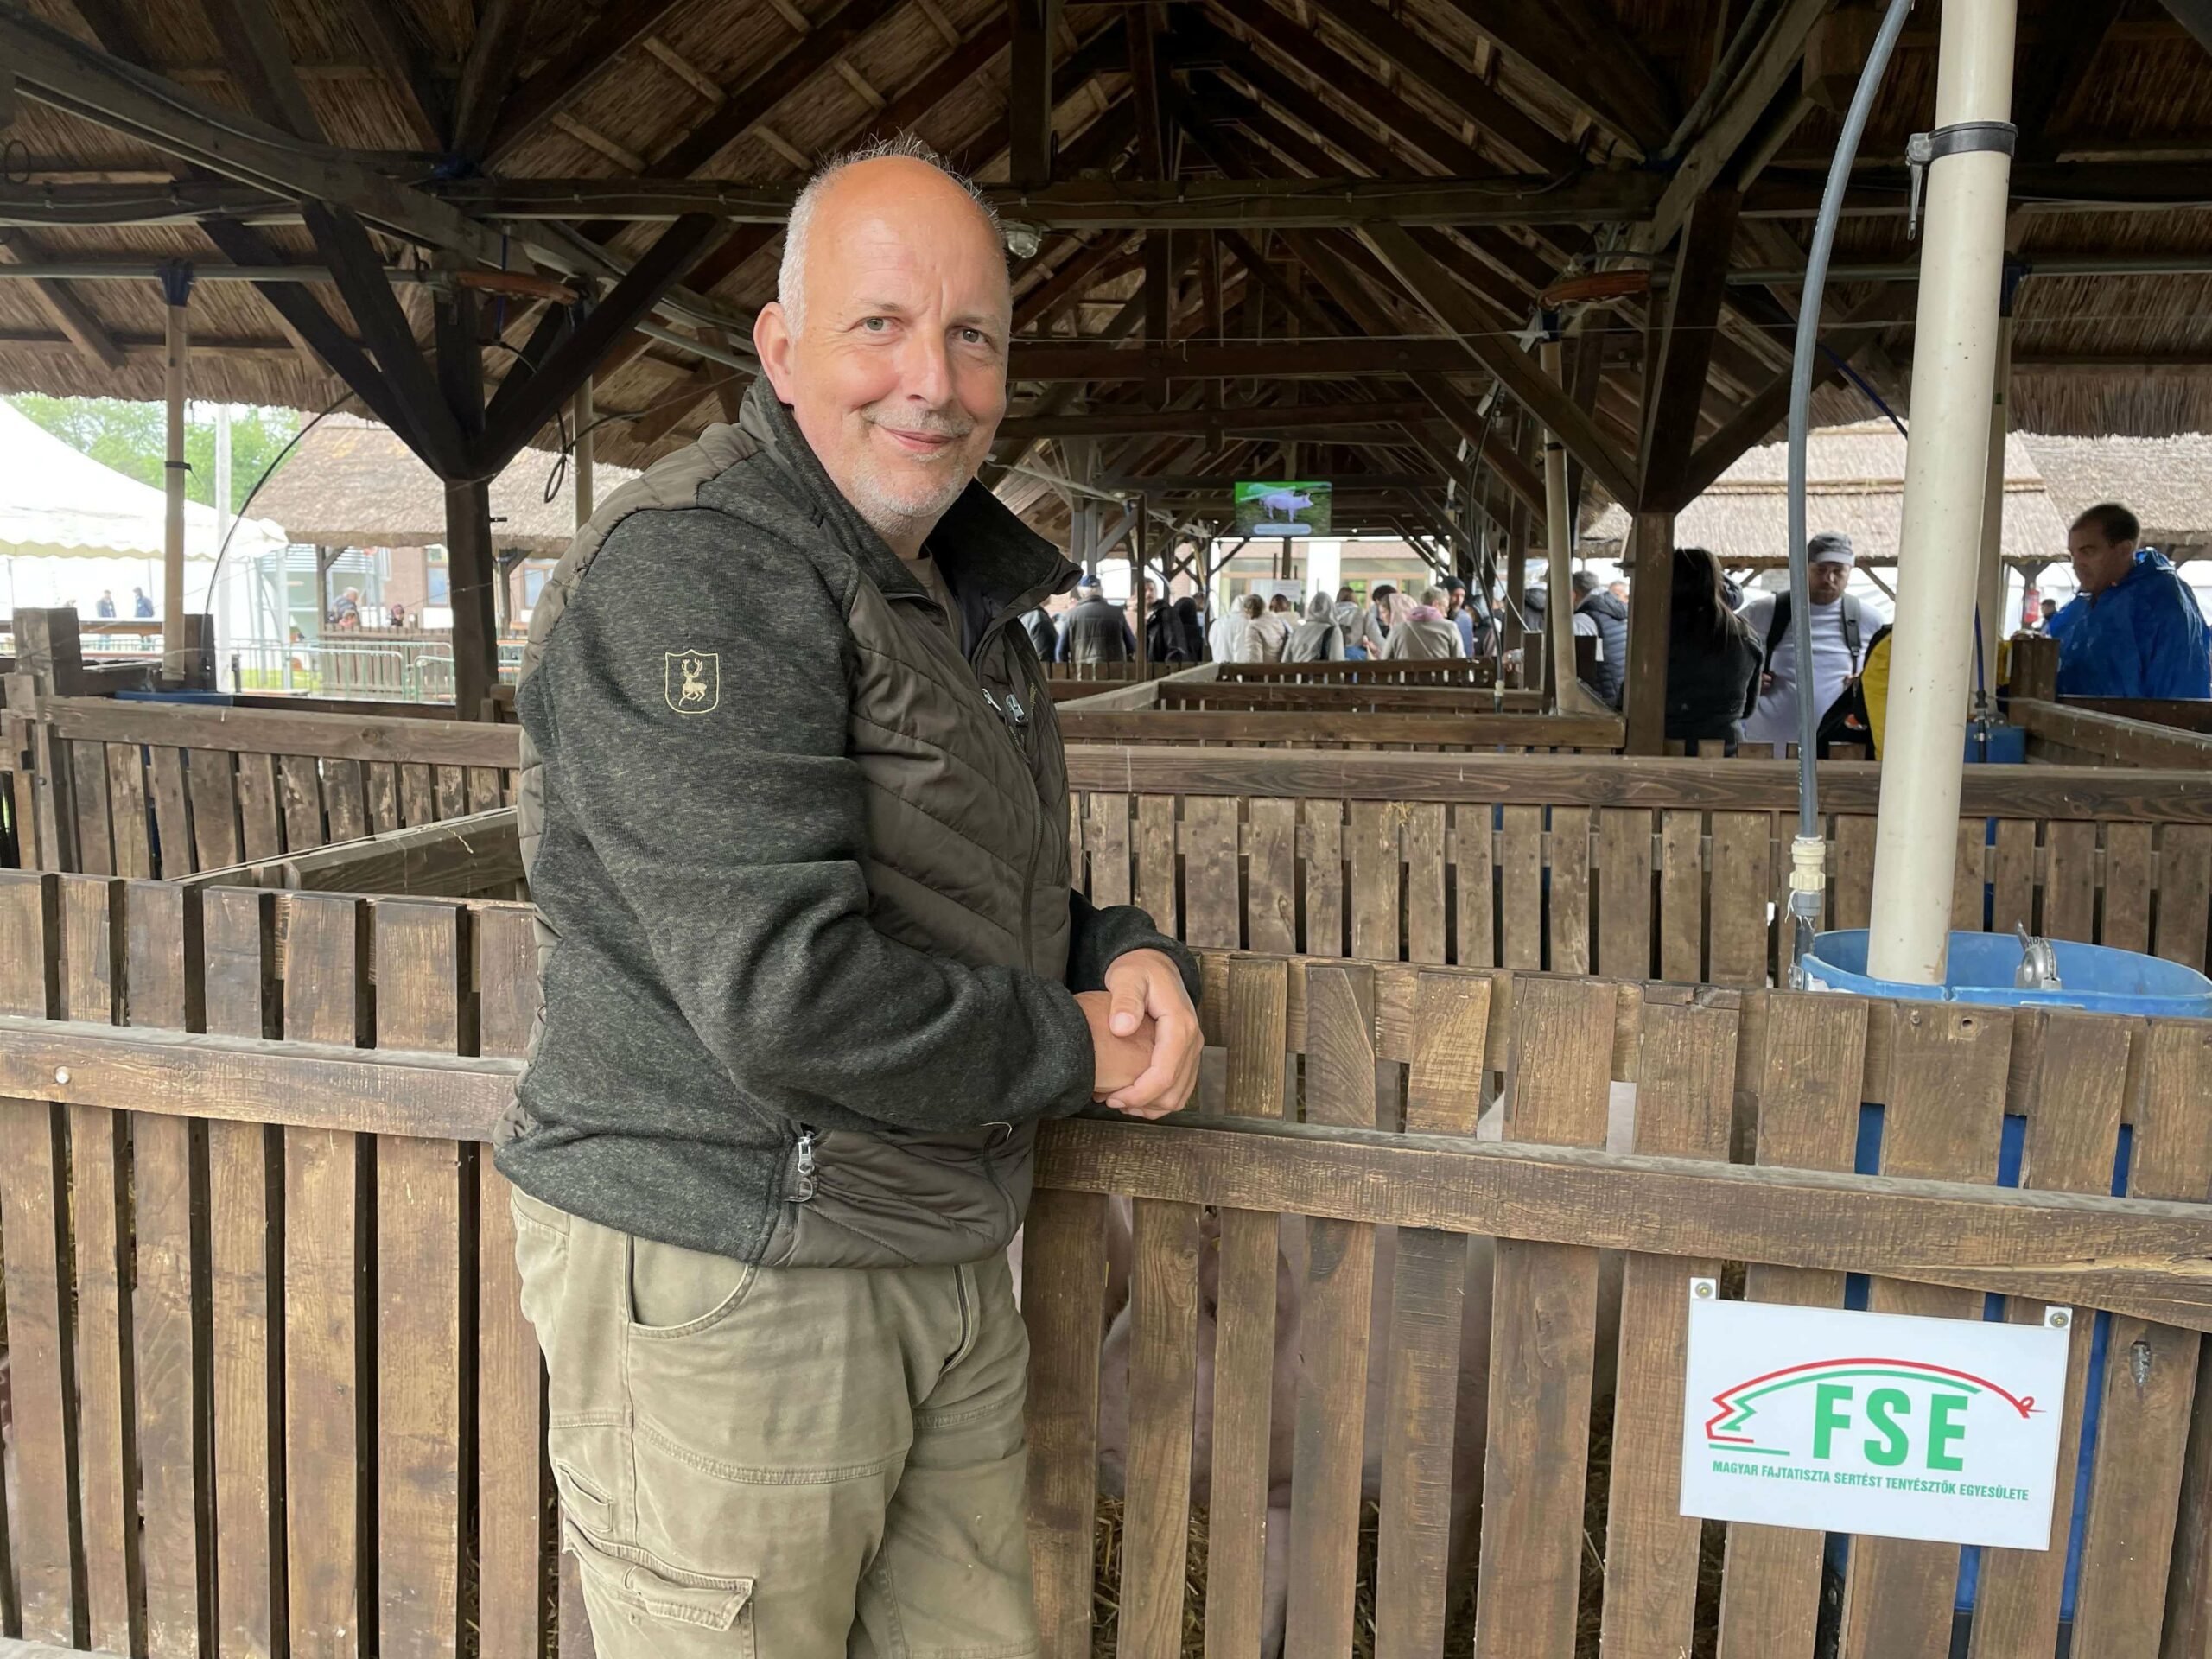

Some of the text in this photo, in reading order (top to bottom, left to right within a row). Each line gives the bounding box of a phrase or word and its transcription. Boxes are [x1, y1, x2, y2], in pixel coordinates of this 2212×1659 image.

[1813, 1383, 1968, 1471] FSE
[1713, 1460, 2029, 1501] MAGYAR FAJTATISZTA SERTÉST TENYÉSZTŐK EGYESÜLETE
